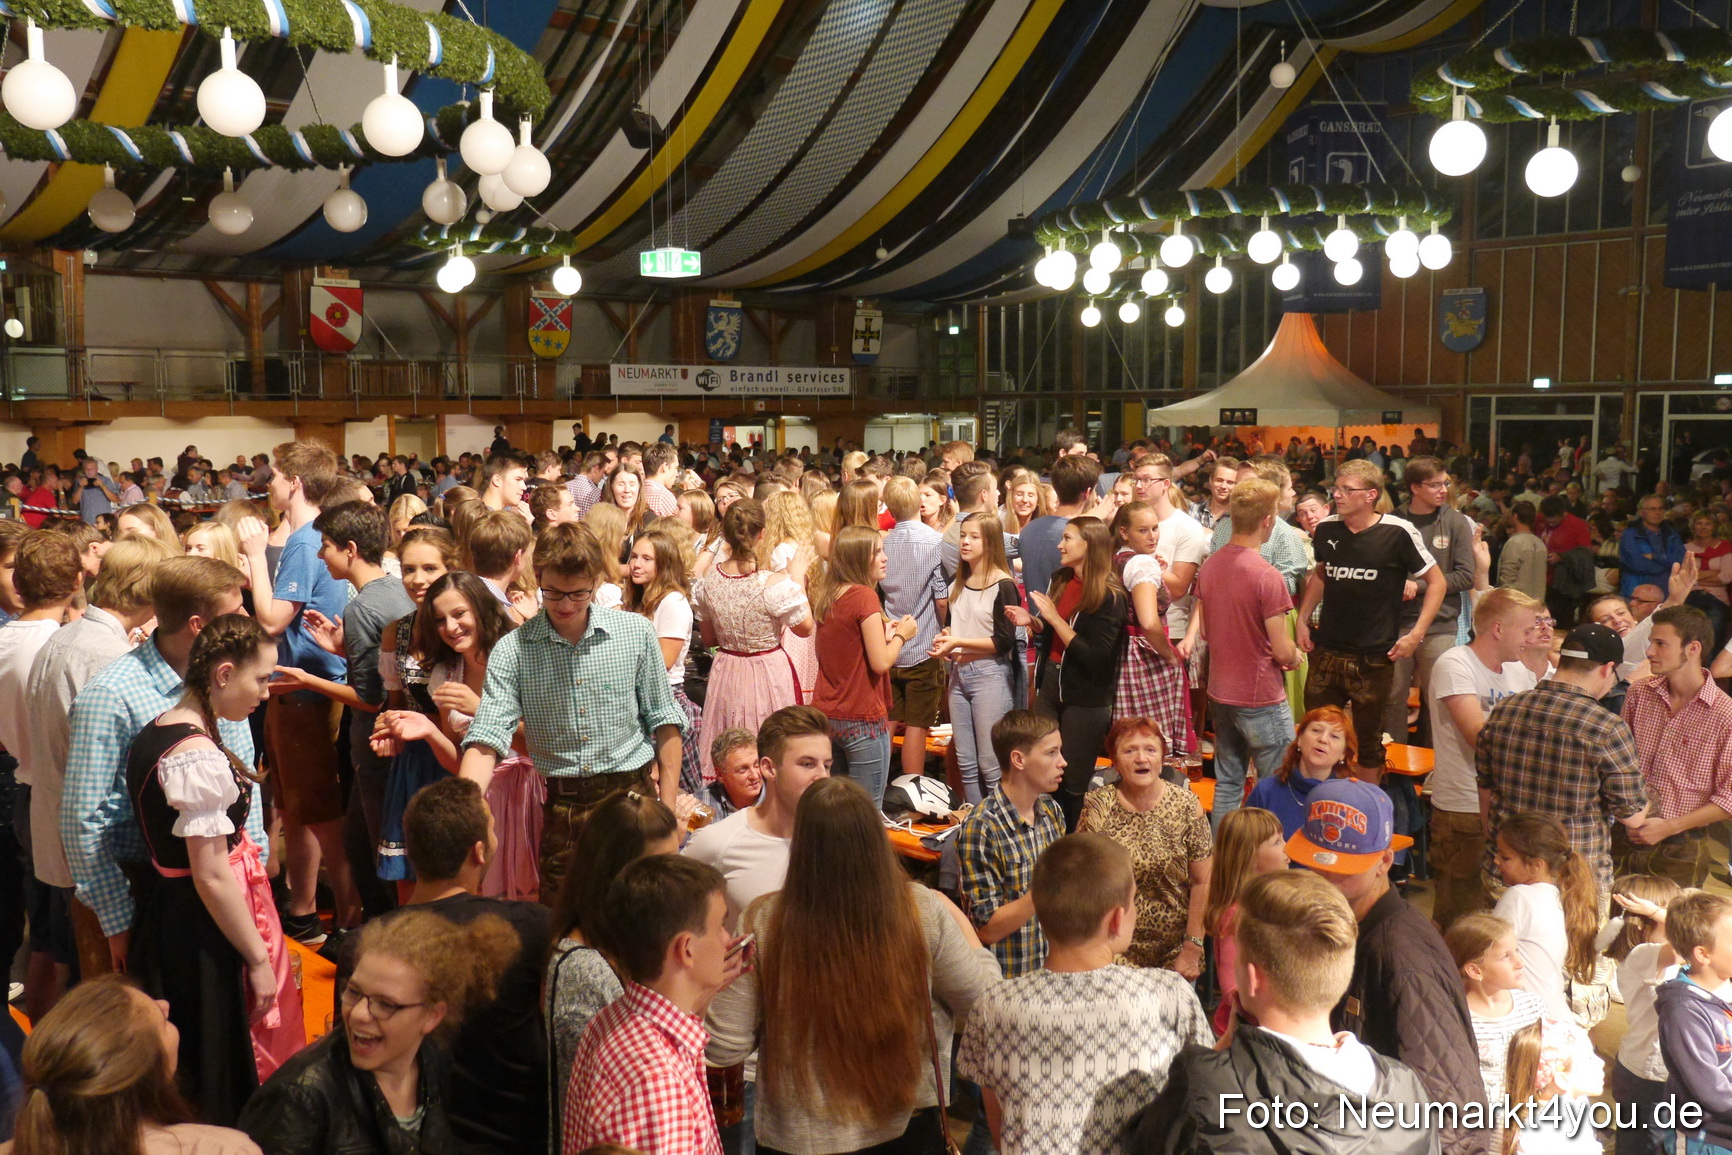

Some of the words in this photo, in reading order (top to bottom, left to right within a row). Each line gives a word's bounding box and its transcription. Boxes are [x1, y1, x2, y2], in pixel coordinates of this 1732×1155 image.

[618, 367, 678, 379] NEUMARKT
[730, 369, 778, 382] Brandl
[787, 371, 845, 383] services
[1325, 562, 1378, 580] tipico
[1308, 800, 1367, 835] KNICKS
